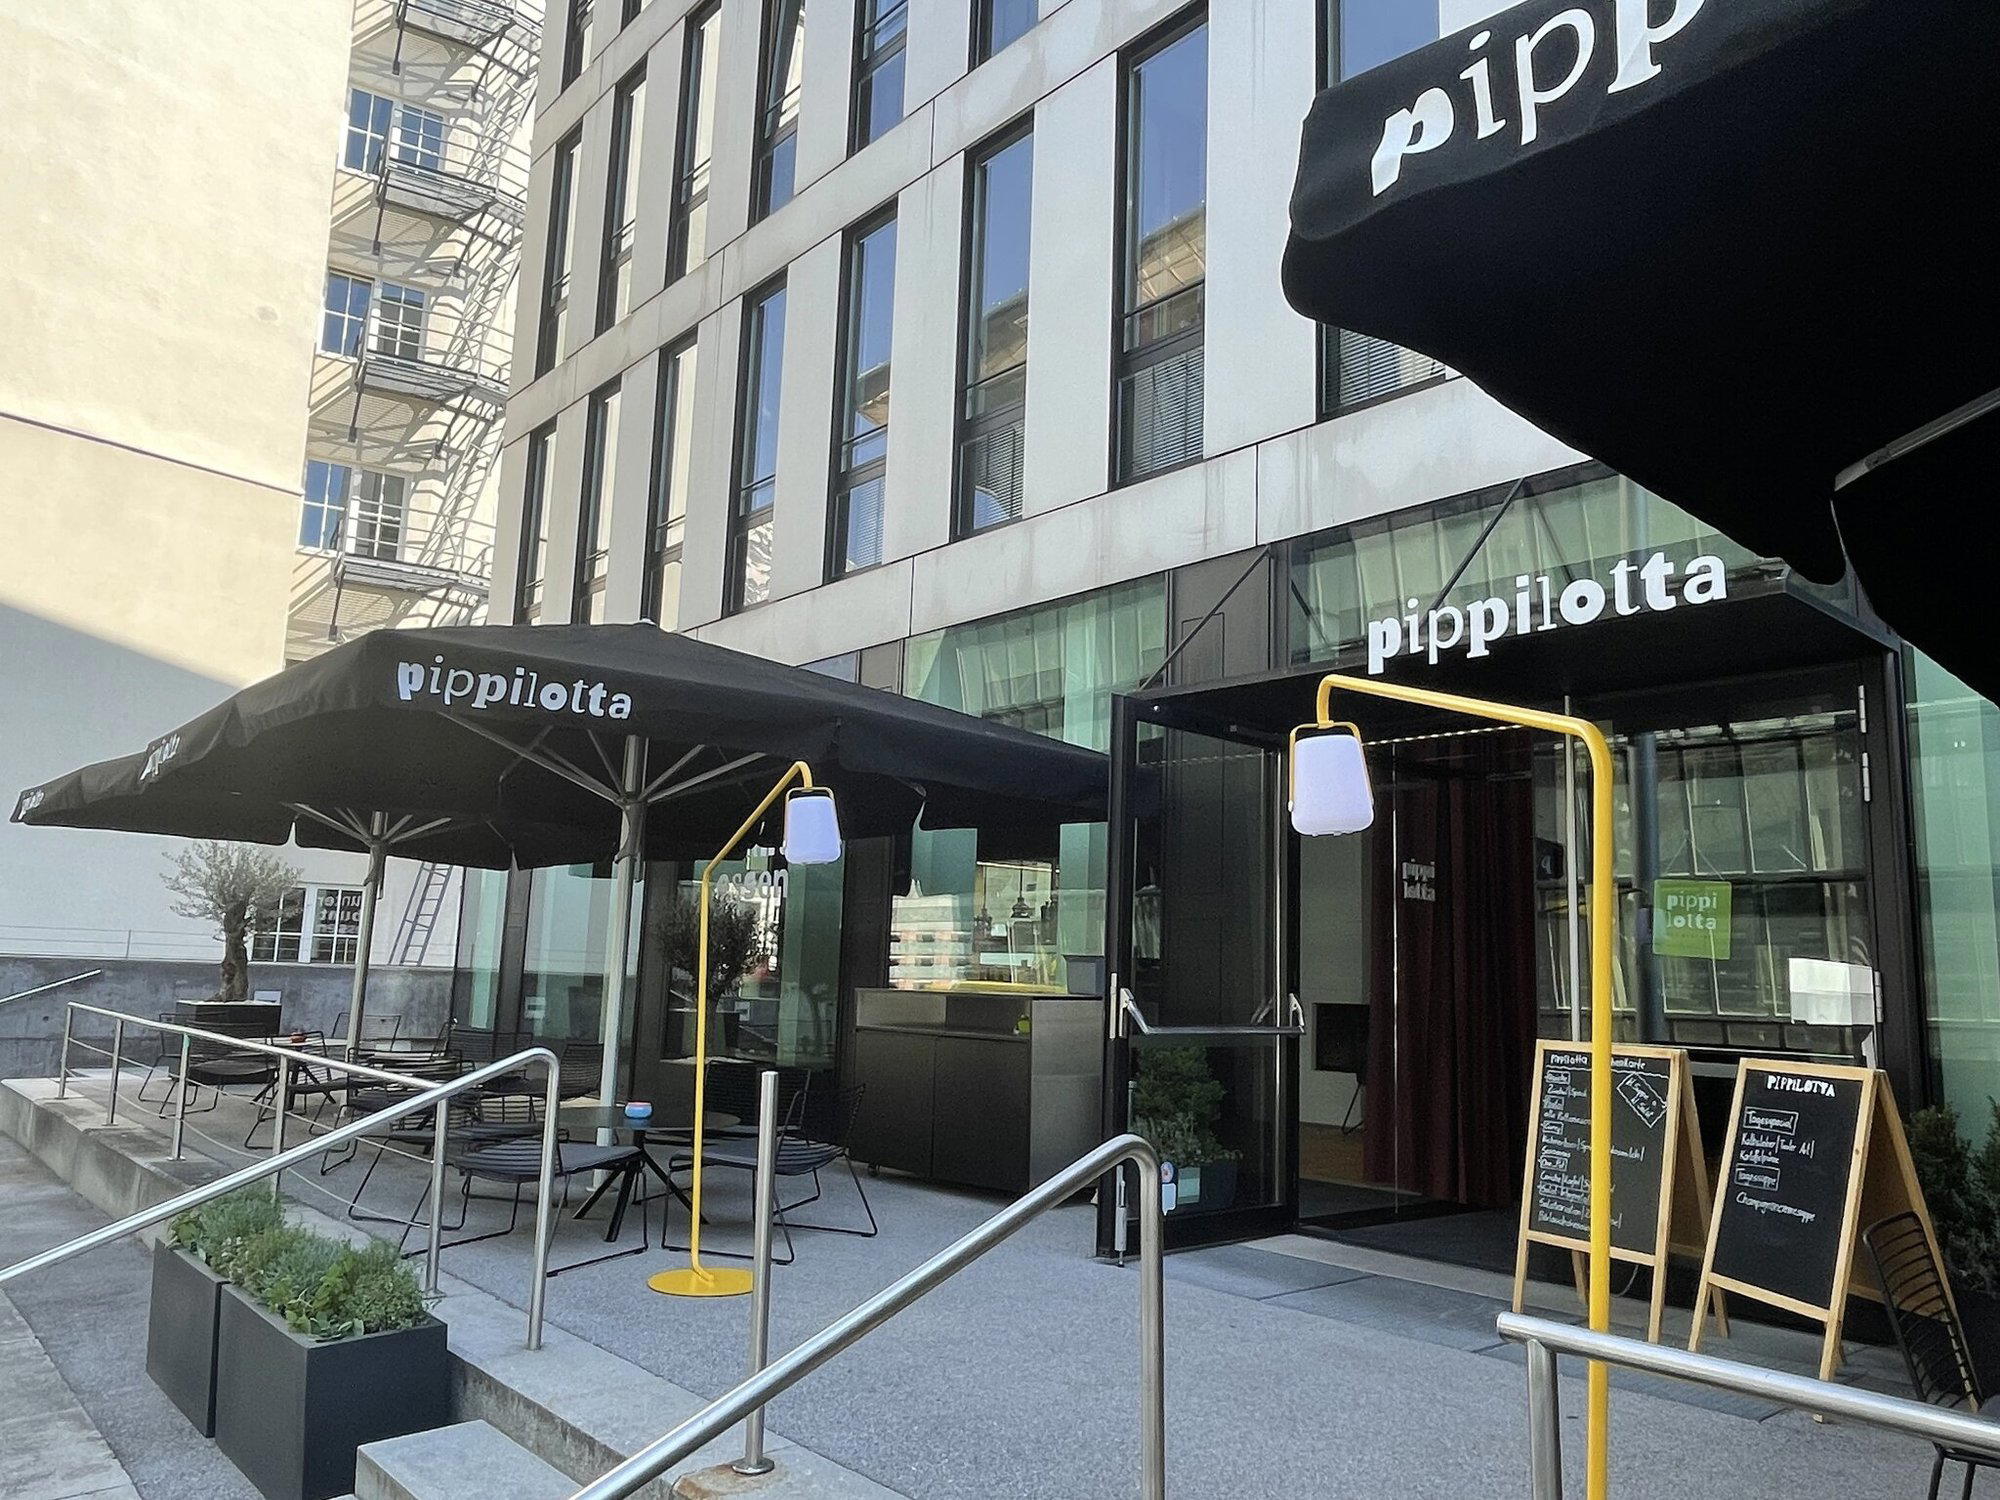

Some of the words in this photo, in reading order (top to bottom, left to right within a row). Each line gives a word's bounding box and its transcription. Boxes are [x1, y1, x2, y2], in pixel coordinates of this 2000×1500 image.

[1367, 551, 1728, 675] pippilotta
[397, 654, 633, 720] pippilotta
[1666, 890, 1718, 912] pippi
[1666, 911, 1717, 930] lotta
[1766, 1075, 1836, 1098] PIPPILOTTA
